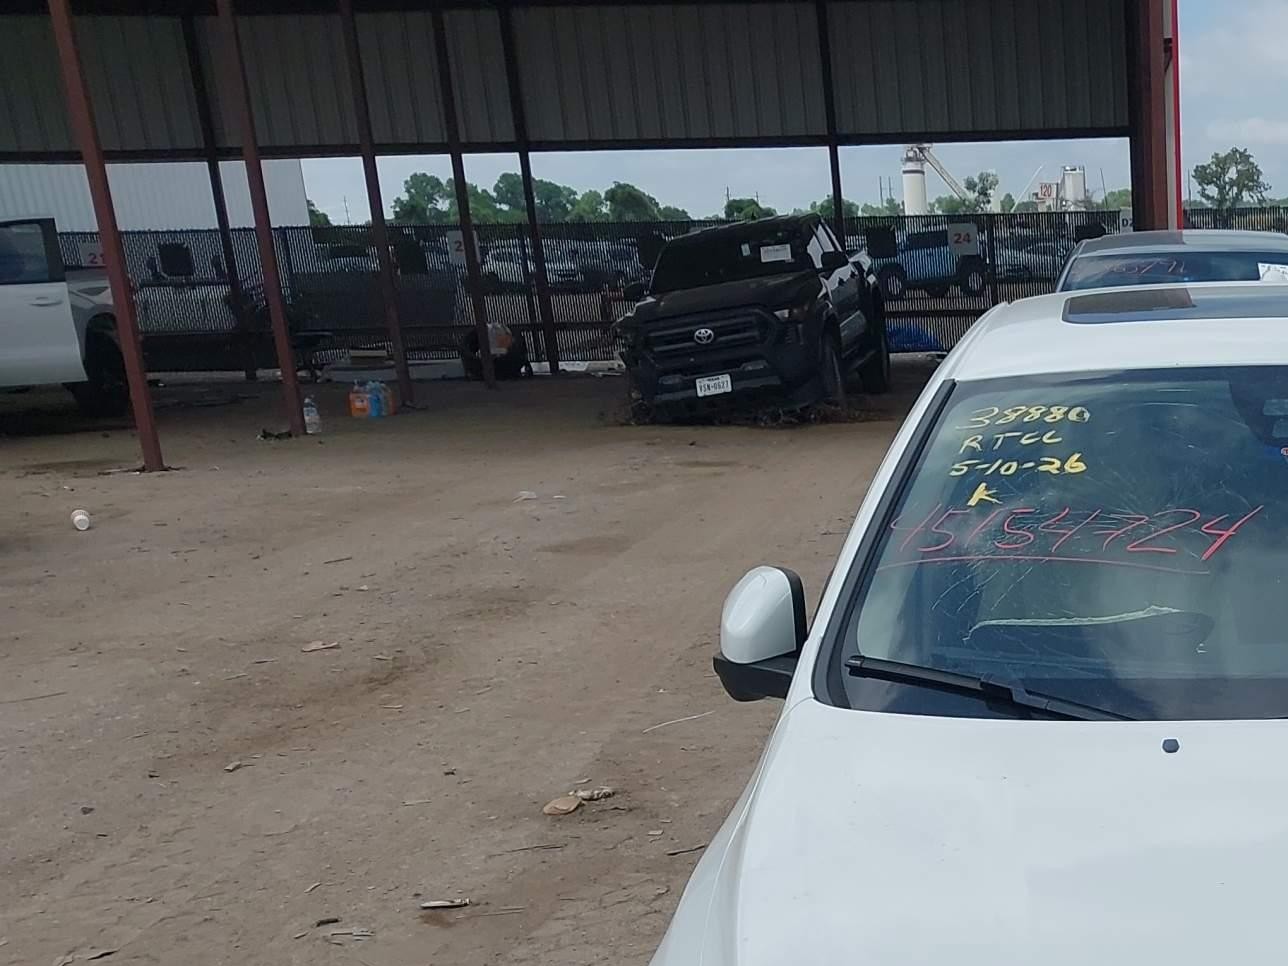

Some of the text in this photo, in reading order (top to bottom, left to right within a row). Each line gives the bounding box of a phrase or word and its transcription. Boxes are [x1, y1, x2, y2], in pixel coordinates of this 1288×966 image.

[953, 232, 972, 244] 24
[949, 452, 1088, 476] 5-10-26
[966, 482, 1003, 507] K
